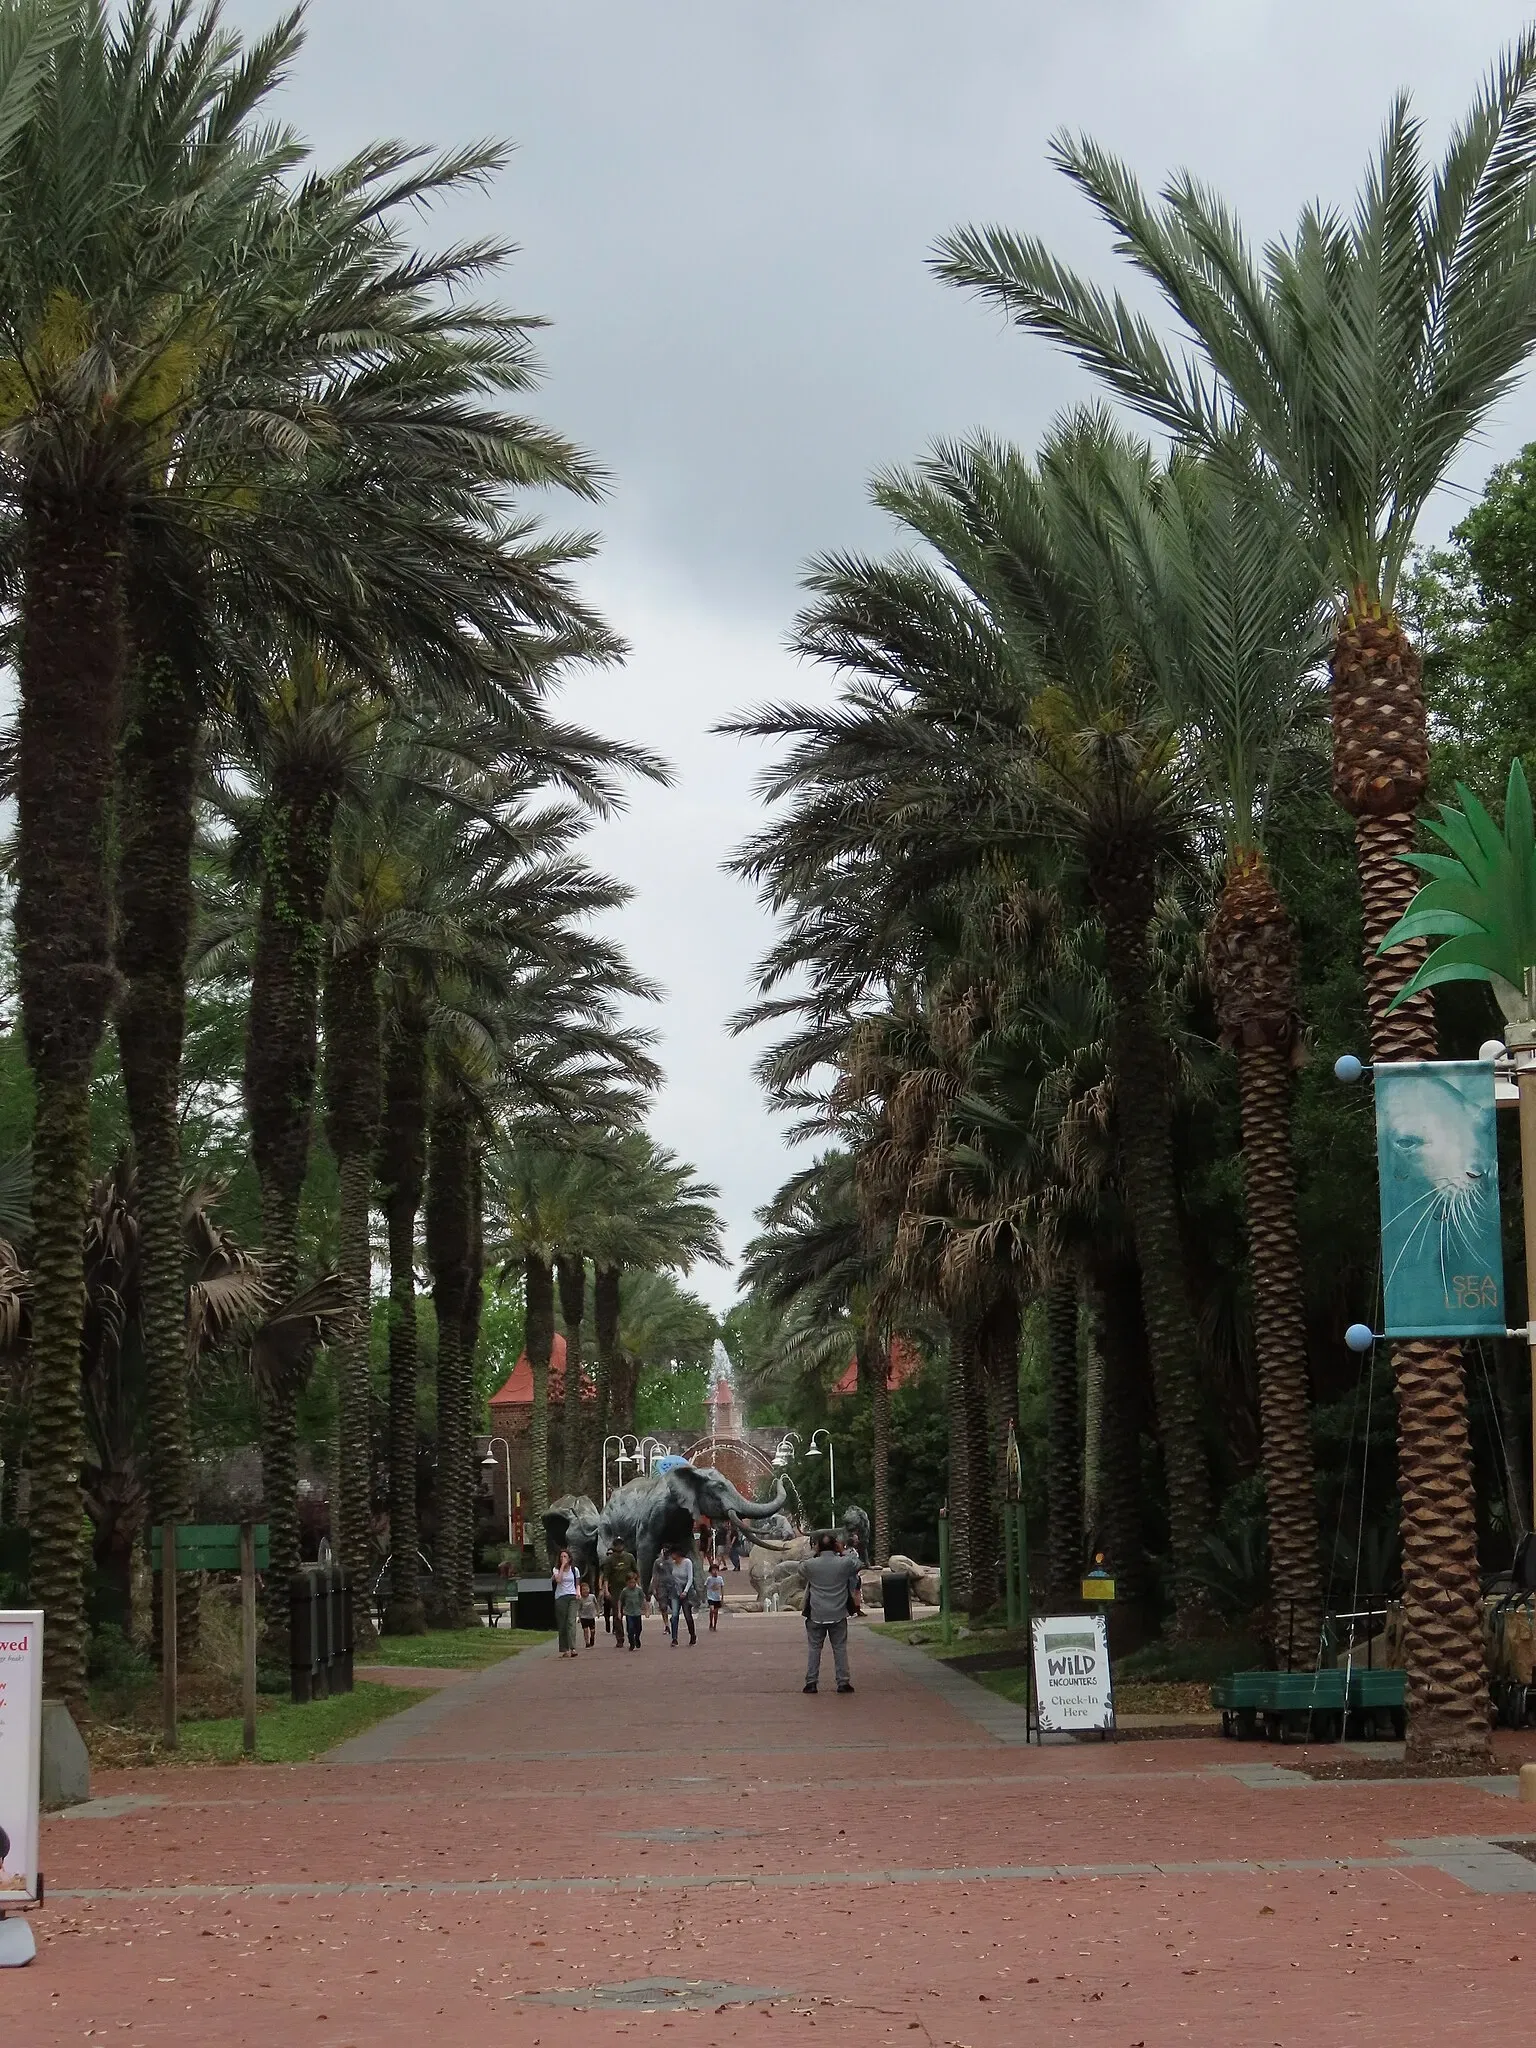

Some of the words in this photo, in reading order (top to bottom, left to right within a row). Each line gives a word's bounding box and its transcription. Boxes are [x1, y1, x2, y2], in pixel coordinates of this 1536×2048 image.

[1453, 1275, 1497, 1291] SEA
[1445, 1291, 1497, 1308] LION
[1049, 1677, 1097, 1687] ENCOUNTERS
[1051, 1695, 1098, 1705] Check-In
[1064, 1708, 1088, 1716] Here
